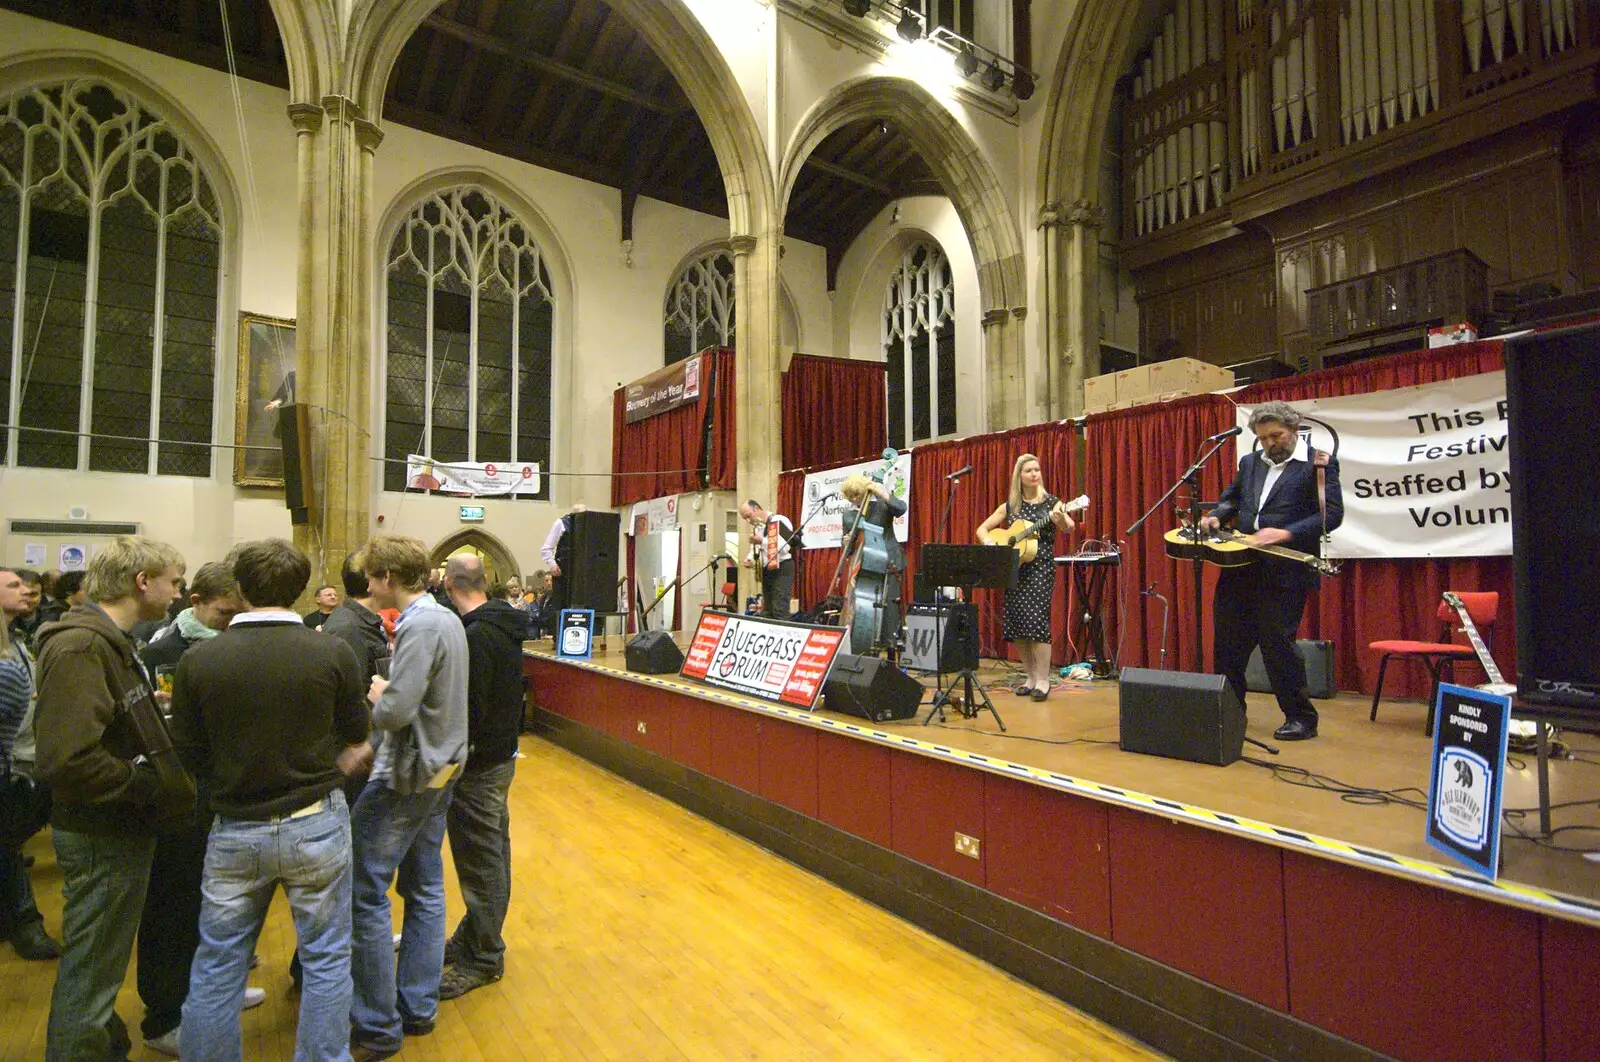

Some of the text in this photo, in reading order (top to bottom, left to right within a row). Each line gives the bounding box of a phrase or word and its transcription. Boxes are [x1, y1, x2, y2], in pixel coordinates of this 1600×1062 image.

[668, 383, 684, 397] Year
[1408, 408, 1485, 434] This
[1407, 434, 1508, 463] Festiv
[1353, 467, 1511, 499] Staffed by
[1408, 504, 1510, 528] Volun
[722, 620, 801, 661] BLUEGRASS
[911, 628, 936, 657] W
[712, 651, 769, 683] FORUM
[1458, 703, 1482, 718] KINDLY
[1449, 714, 1489, 734] SPONSORED
[1463, 731, 1473, 743] BY
